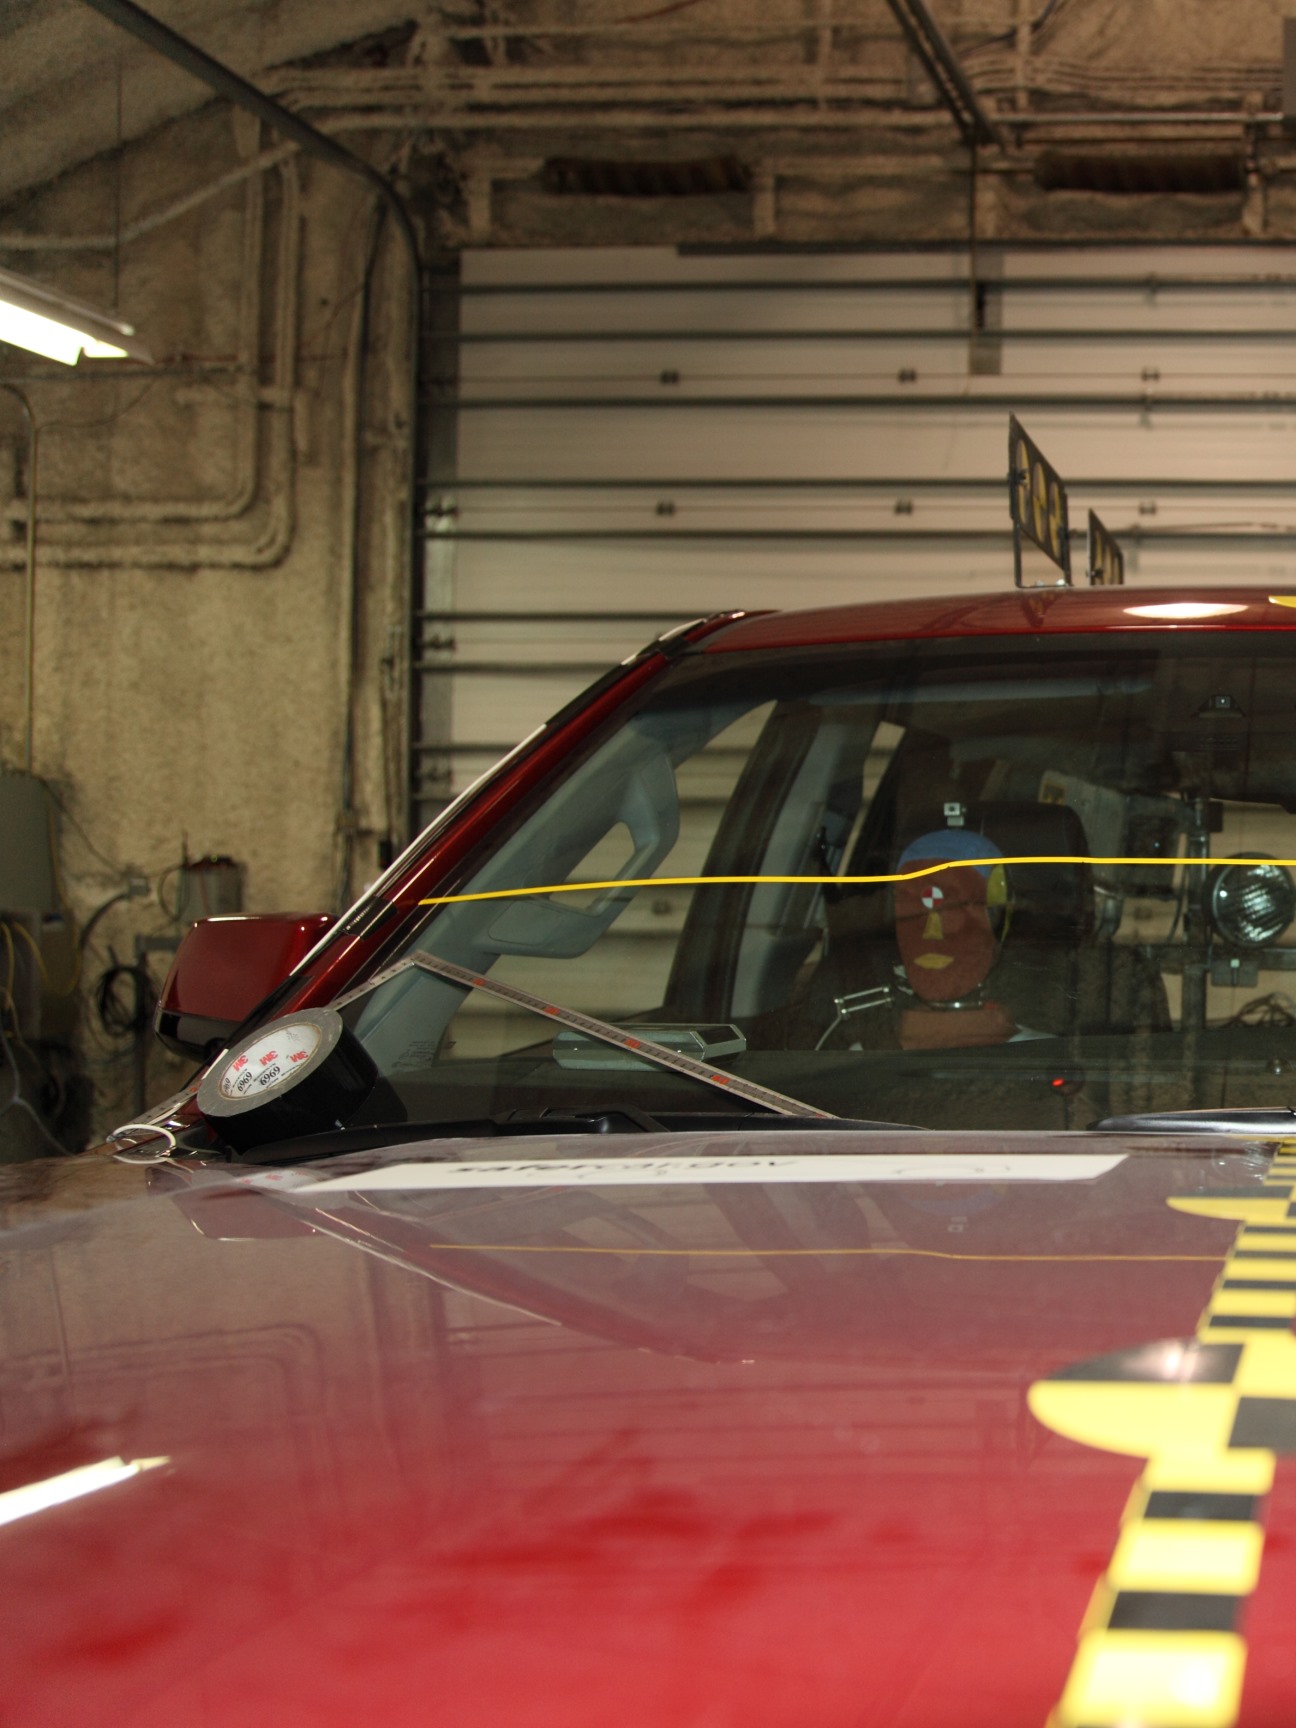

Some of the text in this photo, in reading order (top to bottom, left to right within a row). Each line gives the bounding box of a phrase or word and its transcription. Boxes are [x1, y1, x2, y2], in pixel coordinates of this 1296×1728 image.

[233, 1055, 249, 1072] 3M
[259, 1050, 279, 1066] 3M
[289, 1051, 309, 1063] 3M
[260, 1066, 281, 1086] 6969
